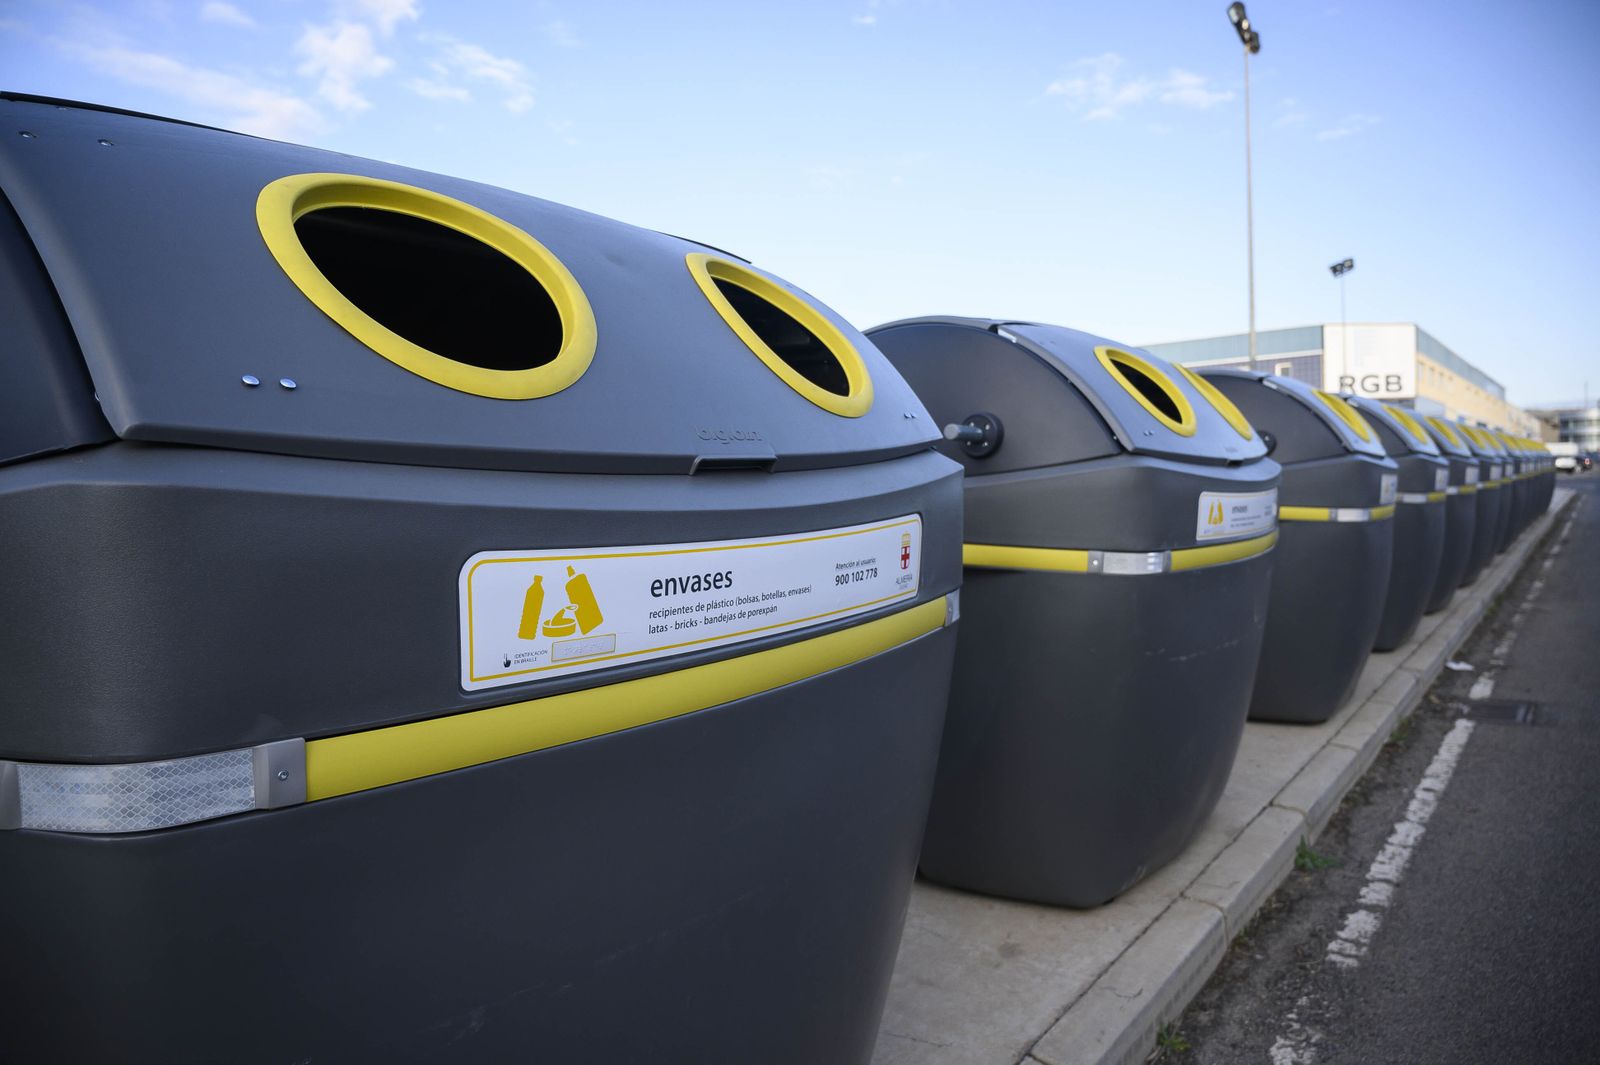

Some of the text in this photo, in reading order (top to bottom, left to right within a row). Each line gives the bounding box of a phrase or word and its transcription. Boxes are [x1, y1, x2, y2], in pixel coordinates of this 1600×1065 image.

[1339, 374, 1402, 396] RGB
[650, 570, 733, 598] envases
[835, 567, 878, 586] 900 102 778
[649, 605, 694, 619] recipientes
[695, 602, 705, 612] de
[706, 598, 734, 612] plástico
[735, 594, 761, 607] (bolsas,
[761, 589, 787, 602] botellas,
[648, 624, 668, 634] latas
[674, 618, 698, 630] bricks
[704, 612, 736, 625] bandejas
[737, 610, 747, 620] de
[747, 604, 778, 619] porexpán
